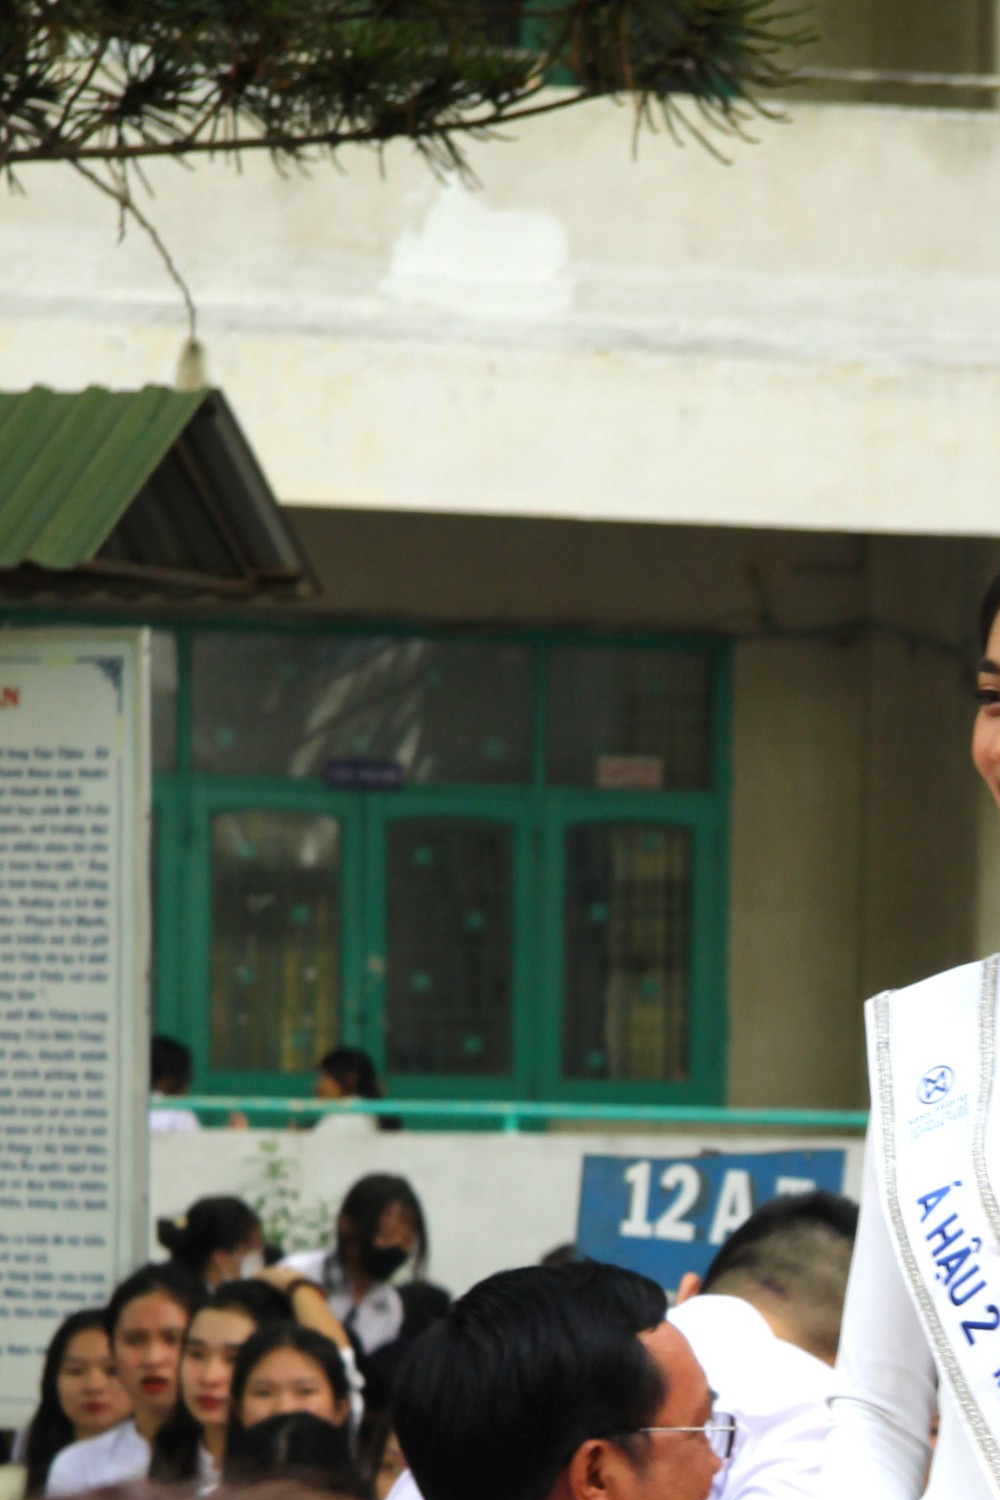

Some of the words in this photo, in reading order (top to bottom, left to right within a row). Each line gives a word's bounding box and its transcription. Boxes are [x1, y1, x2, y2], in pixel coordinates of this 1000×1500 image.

[620, 1161, 815, 1246] 12A
[916, 1180, 962, 1223] Á
[925, 1212, 987, 1307] HẬU
